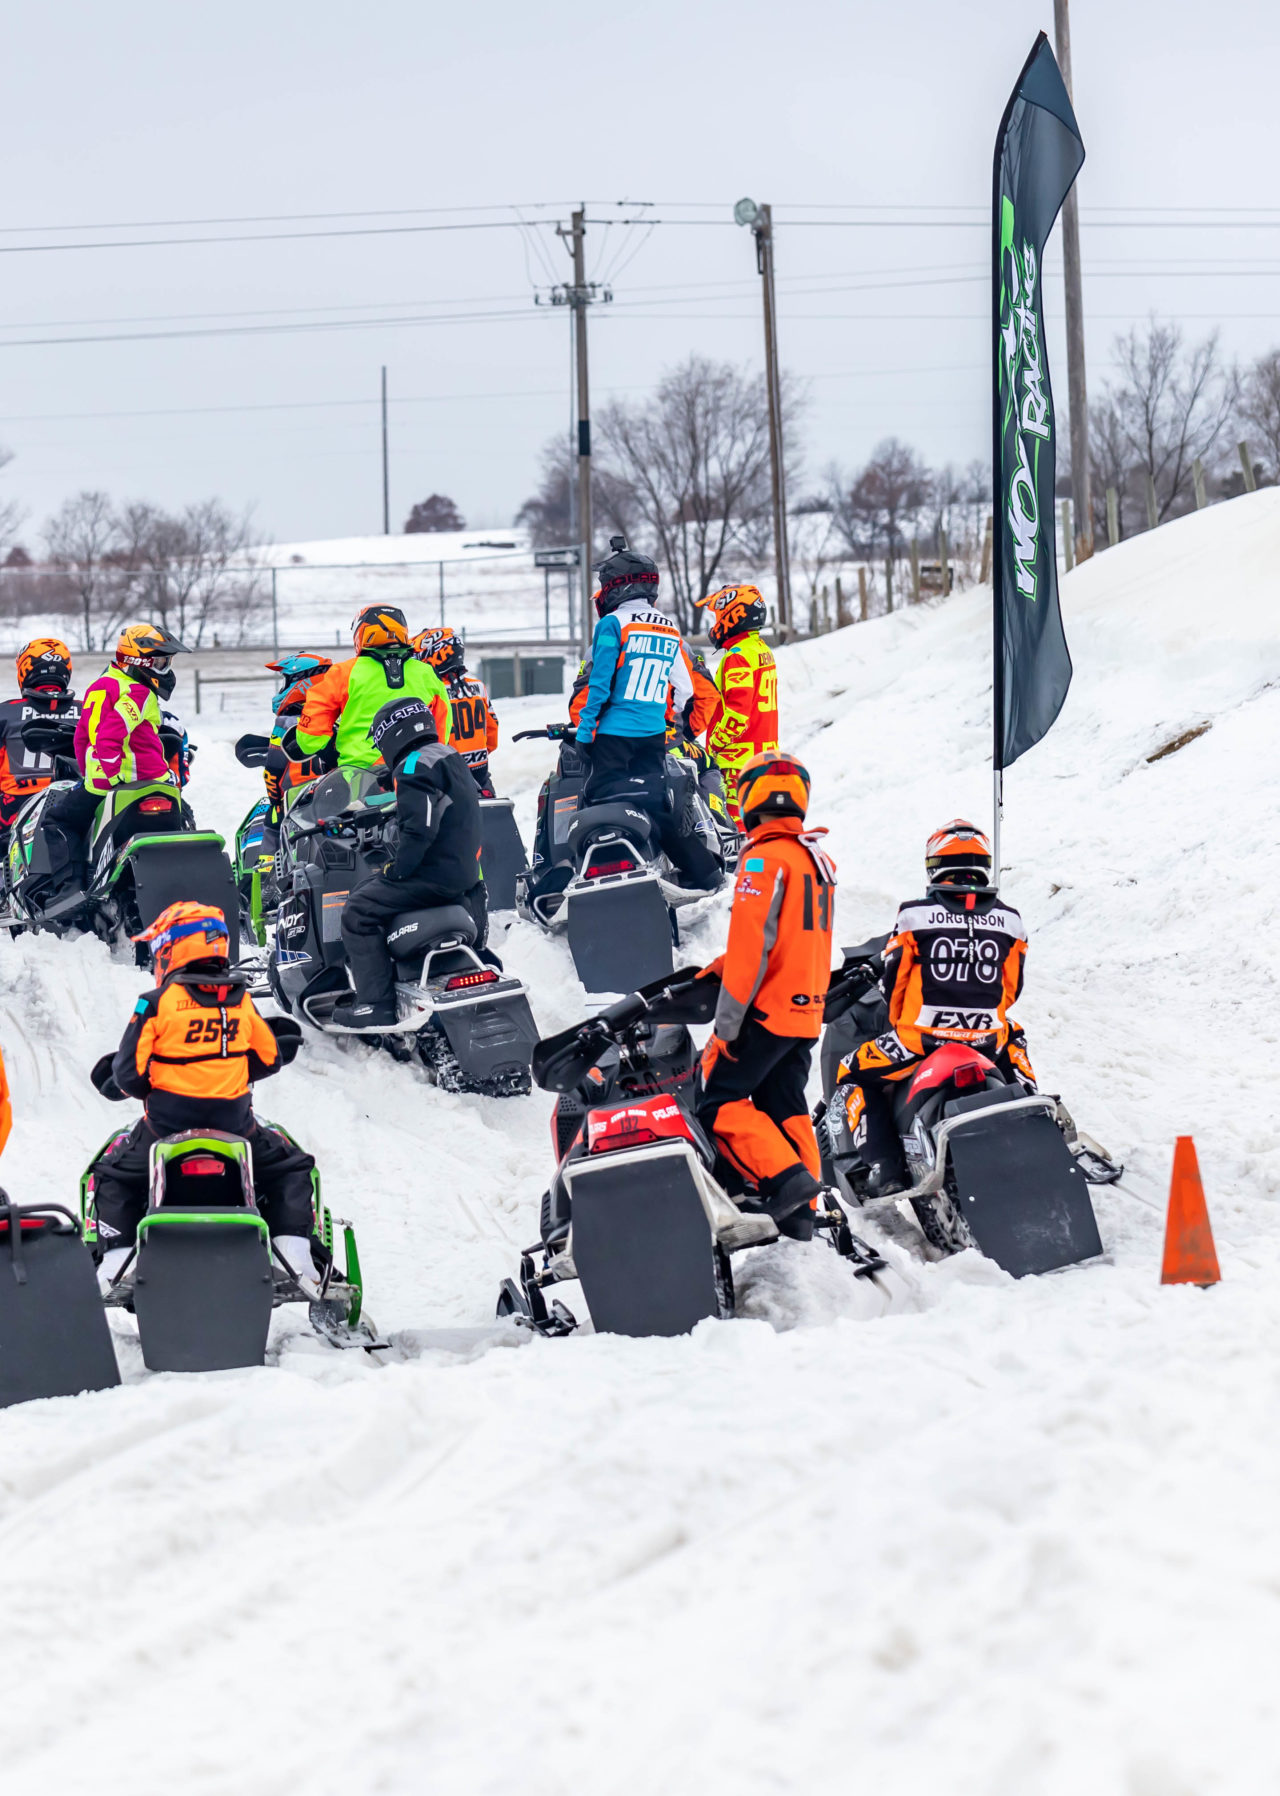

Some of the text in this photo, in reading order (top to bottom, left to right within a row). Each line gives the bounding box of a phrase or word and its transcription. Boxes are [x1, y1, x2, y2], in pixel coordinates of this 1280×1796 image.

[631, 612, 674, 627] Klim
[123, 656, 151, 667] 100%
[387, 923, 419, 944] POLARIS
[930, 937, 1000, 984] 078
[929, 1010, 994, 1030] FXR
[185, 1018, 240, 1044] 254
